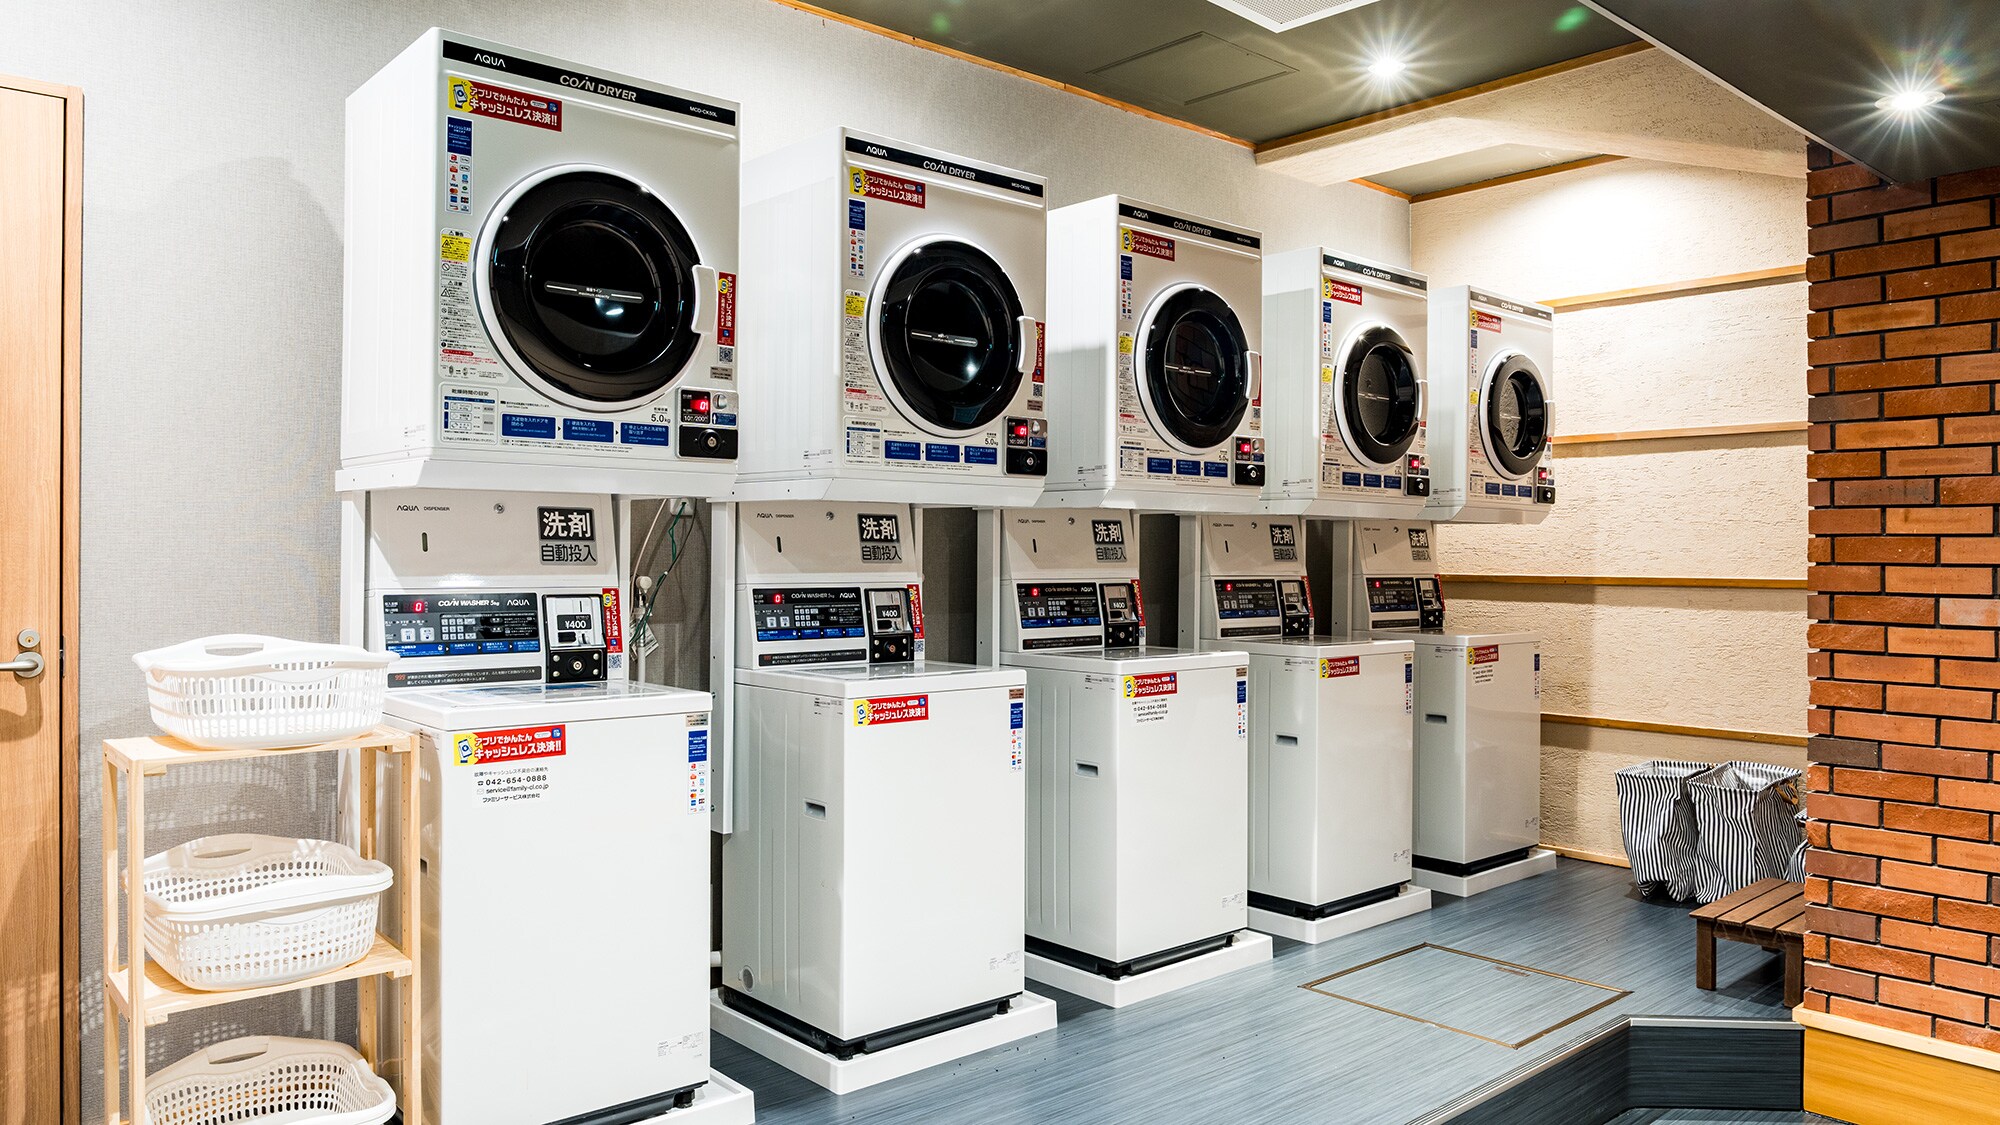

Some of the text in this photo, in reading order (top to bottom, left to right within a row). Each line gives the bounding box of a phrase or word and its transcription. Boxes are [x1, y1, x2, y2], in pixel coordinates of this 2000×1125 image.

[474, 53, 506, 68] AQUA
[470, 87, 528, 107] アプリでかんたん
[597, 84, 637, 101] DRYER
[866, 145, 888, 157] AQUA
[948, 167, 976, 180] DRYER
[1133, 210, 1149, 219] AQUA
[1192, 225, 1212, 236] DRYER
[543, 512, 592, 538] 洗剤
[861, 518, 897, 540] 洗剤
[1095, 523, 1122, 542] 洗剤
[1272, 527, 1294, 544] 洗剤
[542, 544, 597, 563] 自動投入
[862, 545, 902, 561] 自動投入
[565, 620, 587, 629] ¥400
[867, 701, 906, 711] アプリでかんたん
[475, 733, 533, 747] アプリでかんたん
[474, 740, 562, 760] キャッシュレス決済!!
[485, 775, 547, 786] 042-654-0888
